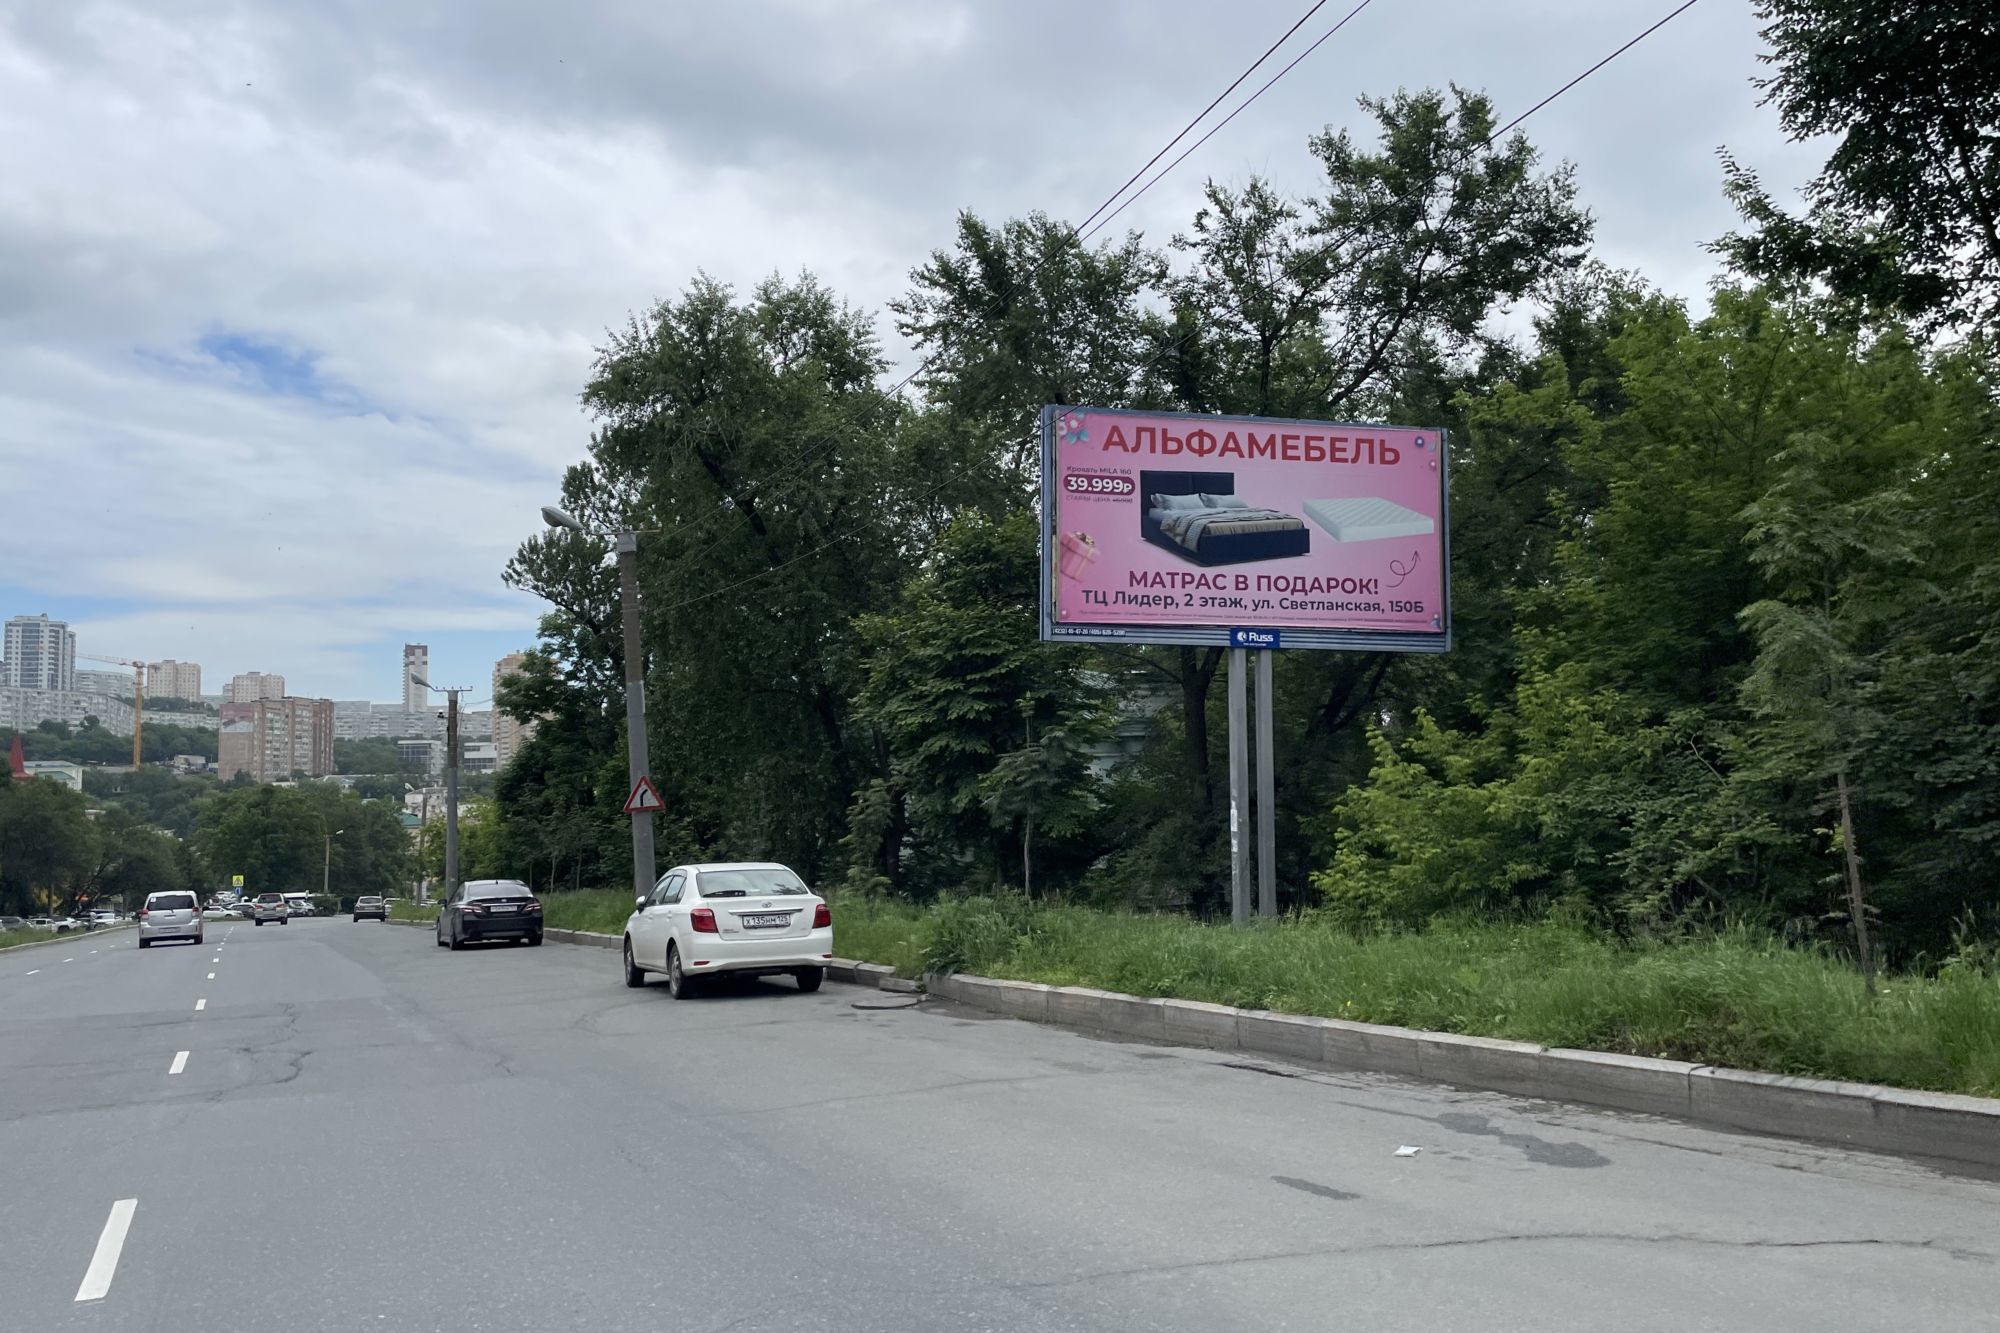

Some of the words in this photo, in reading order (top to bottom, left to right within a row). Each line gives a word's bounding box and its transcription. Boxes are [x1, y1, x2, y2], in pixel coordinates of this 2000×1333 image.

[1102, 425, 1401, 465] АЛЬФАМЕБЕЛЬ
[1129, 570, 1227, 590] МАТРАС
[1234, 574, 1249, 591] В
[1256, 575, 1379, 595] ПОДАРОК!
[1082, 590, 1108, 606] ТЦ
[1113, 591, 1179, 609] Лидер,
[1183, 593, 1194, 607] 2
[1199, 596, 1247, 610] этаж,
[1252, 599, 1275, 611] ул.
[1279, 597, 1385, 614] Светланская,
[1388, 600, 1424, 613] 150Б
[1249, 632, 1274, 642] Russ
